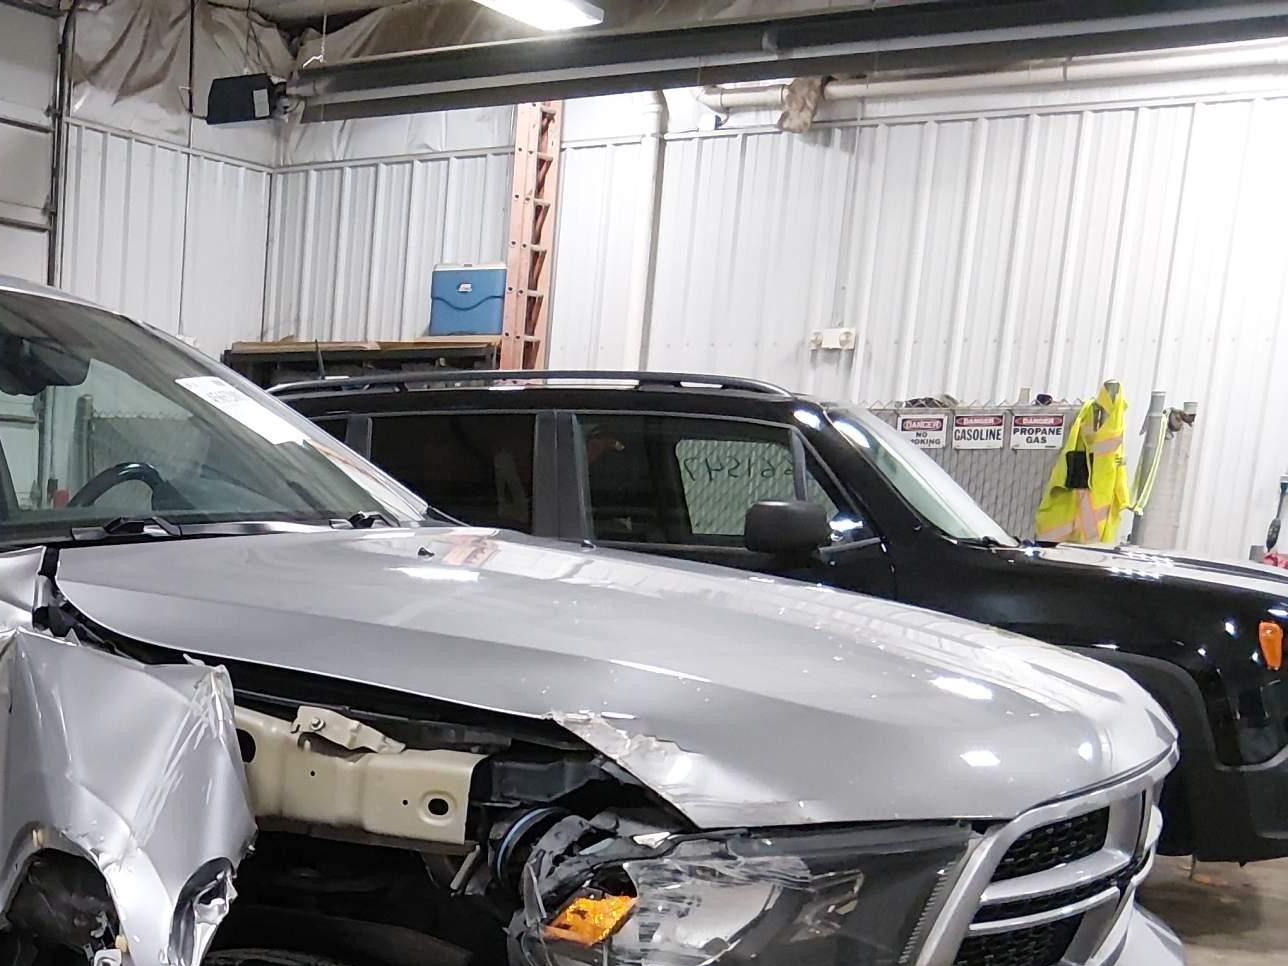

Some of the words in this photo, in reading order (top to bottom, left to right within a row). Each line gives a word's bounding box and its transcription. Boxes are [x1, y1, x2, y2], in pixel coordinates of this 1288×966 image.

[903, 420, 942, 429] DANGER
[964, 416, 995, 425] DANGER
[1023, 416, 1054, 425] DANGER
[954, 428, 1002, 441] GASOLINE
[1013, 427, 1062, 436] PROPANE
[1025, 435, 1048, 444] GAS
